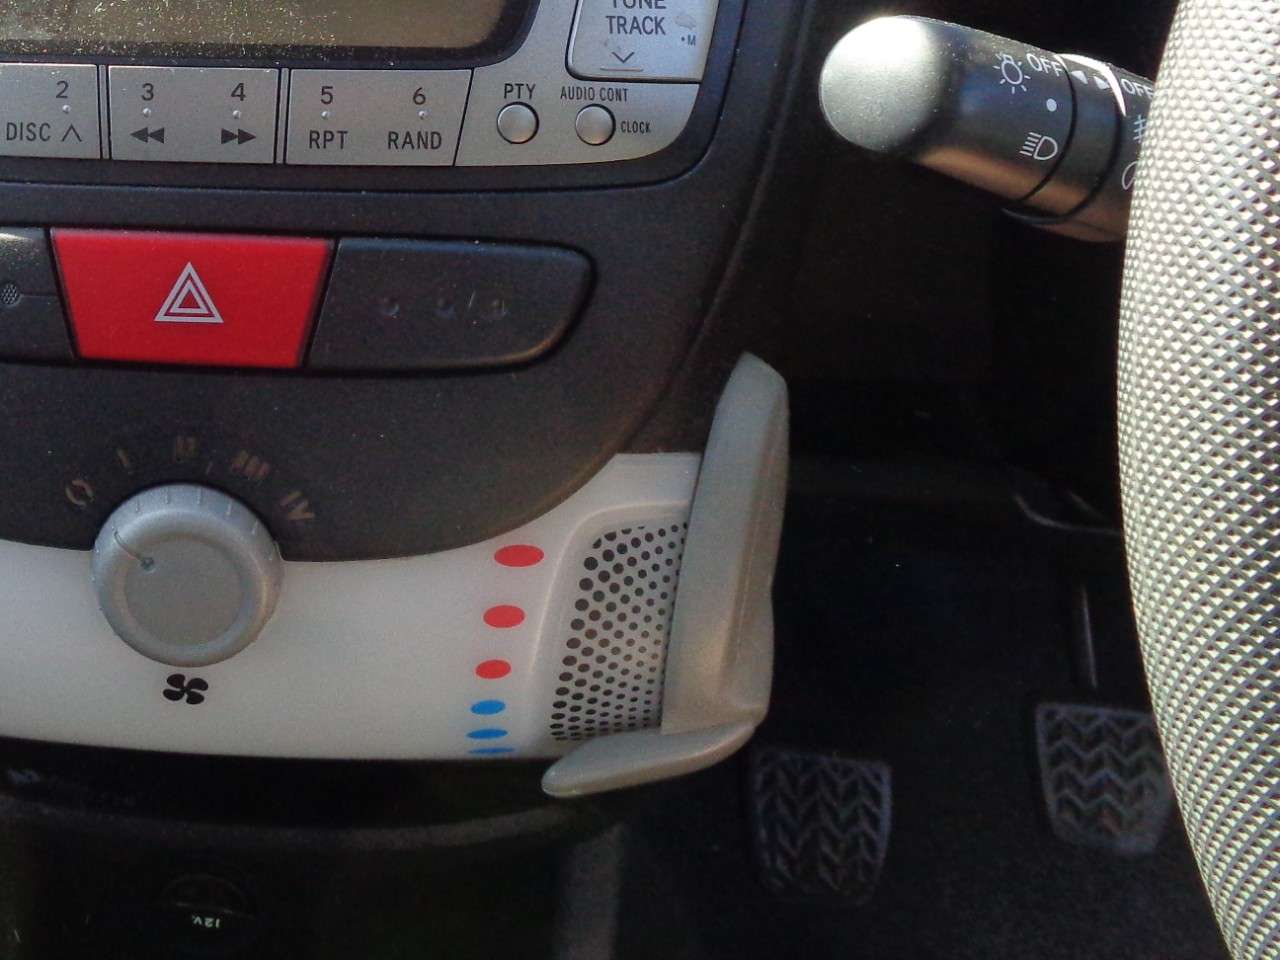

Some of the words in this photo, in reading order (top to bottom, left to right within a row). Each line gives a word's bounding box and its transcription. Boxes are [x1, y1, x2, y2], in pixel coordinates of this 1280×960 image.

[605, 16, 666, 36] TRACK
[1026, 53, 1062, 76] OFF
[56, 81, 69, 99] 2
[142, 83, 154, 101] 3
[231, 83, 247, 101] 4
[321, 87, 334, 105] 5
[413, 87, 426, 105] 6
[504, 83, 536, 100] PTY
[561, 86, 595, 101] AUDIO
[600, 87, 628, 102] CONT
[6, 123, 51, 142] DISC
[621, 120, 651, 134] CLOCK
[309, 131, 348, 149] RPT
[388, 131, 442, 150] RAND
